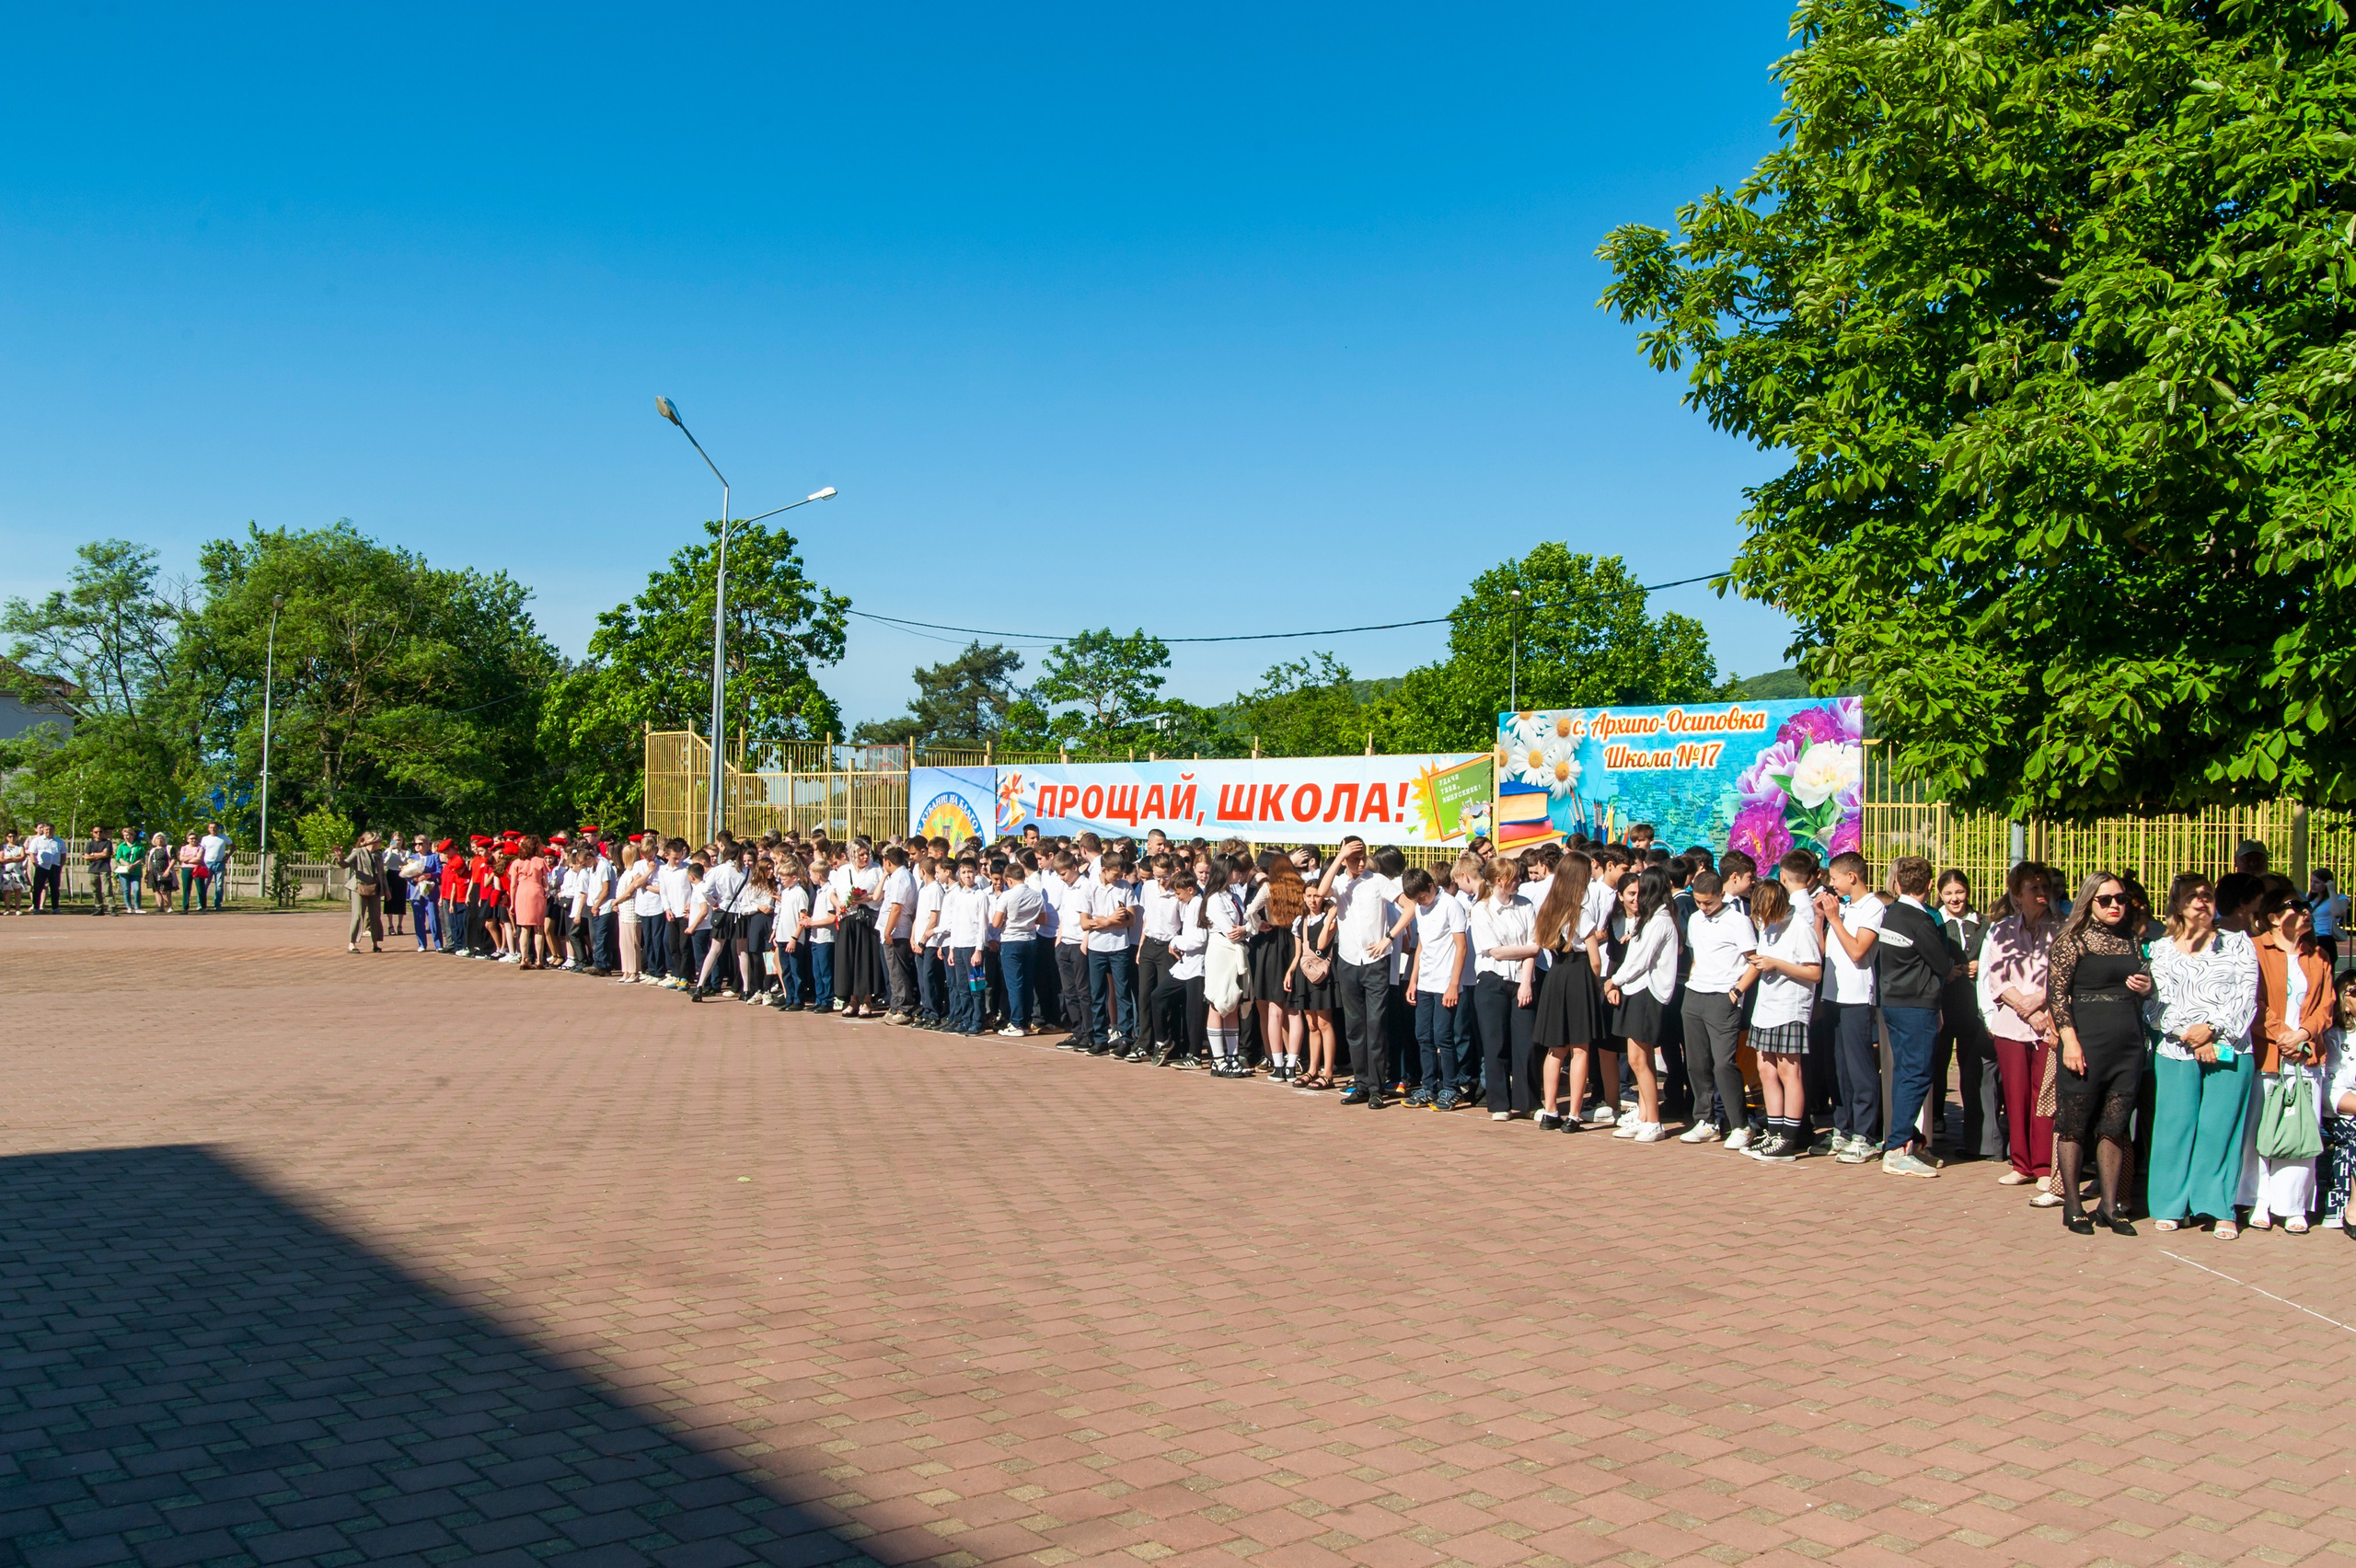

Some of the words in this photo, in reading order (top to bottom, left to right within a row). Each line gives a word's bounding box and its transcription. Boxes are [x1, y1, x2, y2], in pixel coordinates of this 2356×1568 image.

[1572, 720, 1586, 735] с.
[1590, 708, 1766, 741] Архипо-Осиповка
[1604, 745, 1672, 768] Школа
[1676, 744, 1722, 767] №17
[1438, 773, 1460, 786] УДАЧИ
[1440, 783, 1461, 795] ТЕБЕ,
[1035, 774, 1206, 827] ПРОЩАЙ,
[1216, 780, 1410, 824] ШКОЛА!
[1442, 784, 1482, 803] ВЫПУСКНИК!
[920, 794, 948, 824] КУБАНИ!
[949, 794, 959, 806] НА
[959, 799, 979, 829] БЛАГО
